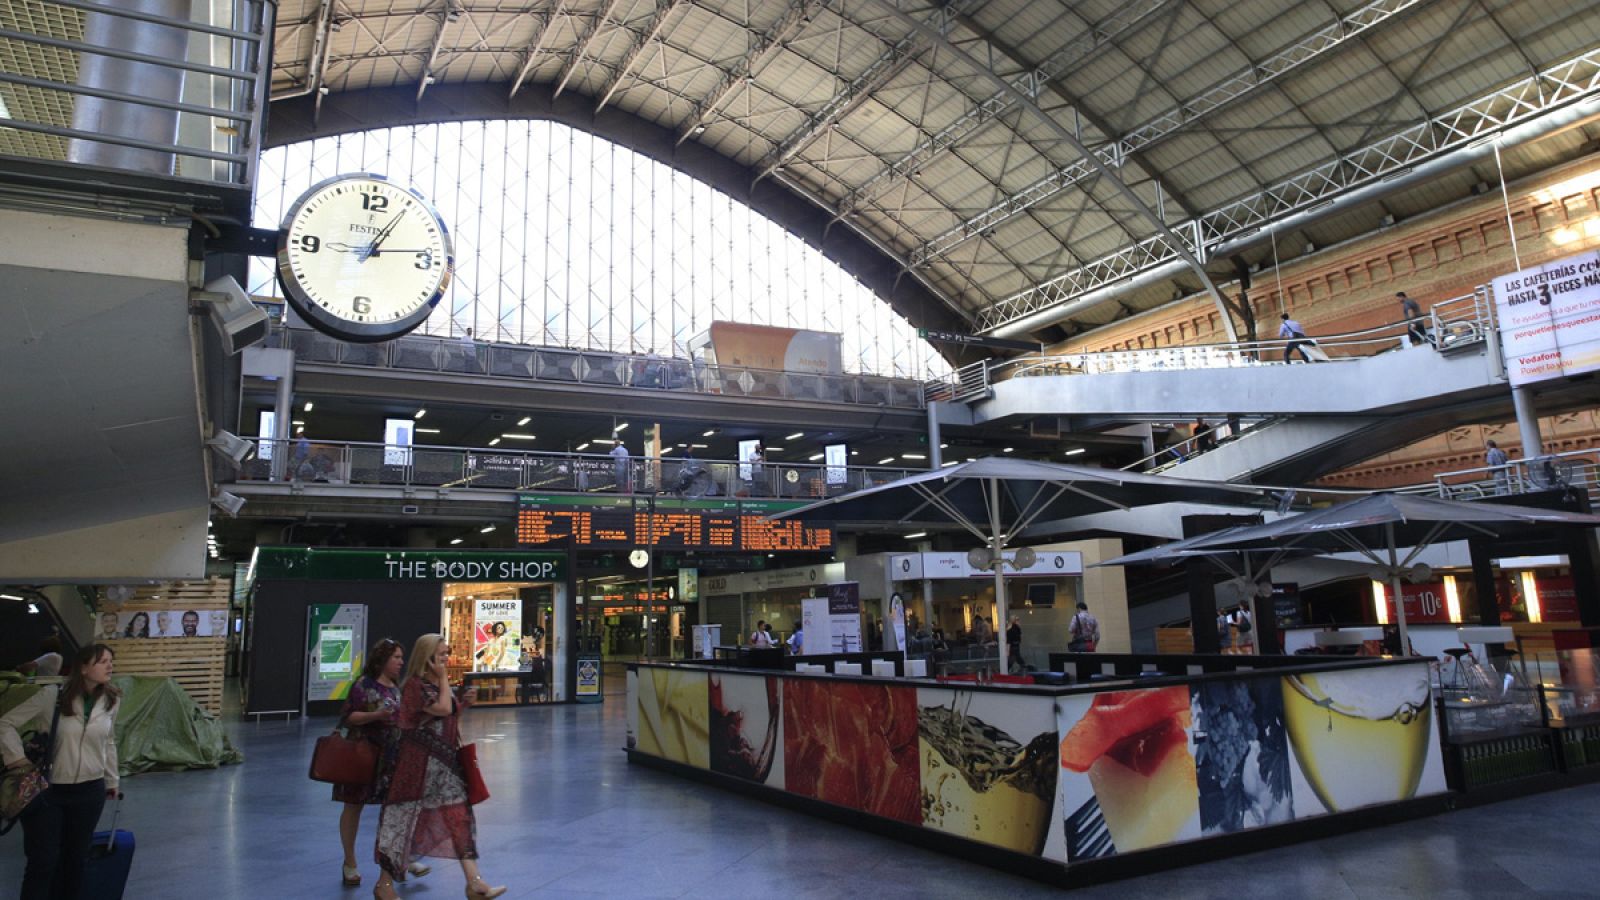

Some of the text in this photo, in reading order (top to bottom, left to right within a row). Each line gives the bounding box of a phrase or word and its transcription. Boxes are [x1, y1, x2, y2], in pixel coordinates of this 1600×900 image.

[360, 192, 389, 214] 12
[301, 235, 320, 253] 9
[415, 251, 433, 270] 3
[1505, 279, 1521, 292] LAS
[1507, 289, 1537, 306] HASTA
[1537, 283, 1552, 306] 3
[1552, 278, 1581, 295] VECES
[353, 296, 372, 314] 6
[1519, 351, 1561, 365] Vodafone
[384, 560, 427, 579] THE
[435, 561, 494, 579] BODY
[481, 602, 517, 610] SUMMER
